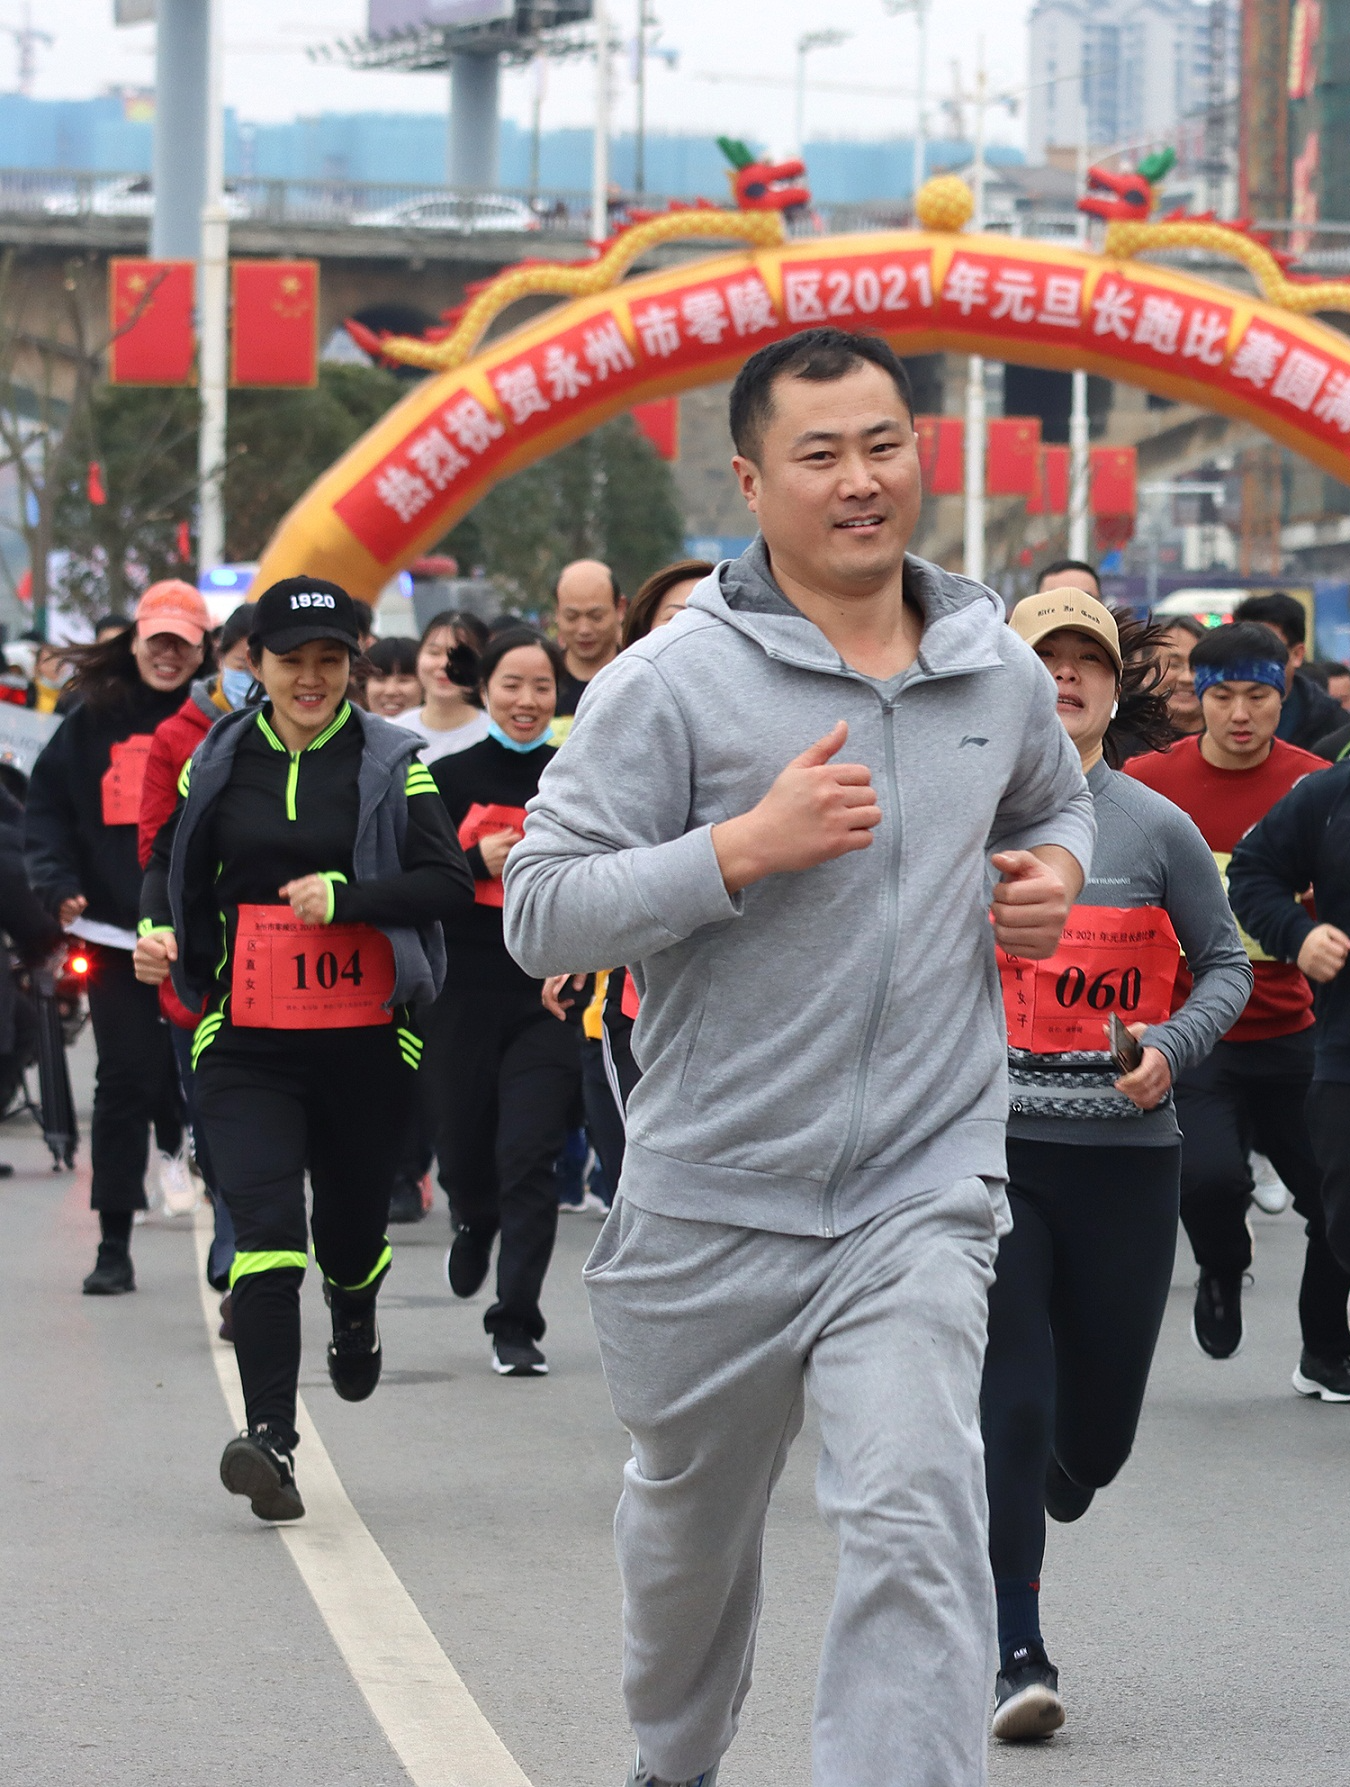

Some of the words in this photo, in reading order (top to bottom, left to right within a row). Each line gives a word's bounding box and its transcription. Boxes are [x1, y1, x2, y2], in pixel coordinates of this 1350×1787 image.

[290, 592, 336, 610] 1920
[1076, 931, 1096, 941] 2021
[291, 950, 364, 990] 104
[1055, 965, 1142, 1011] 060
